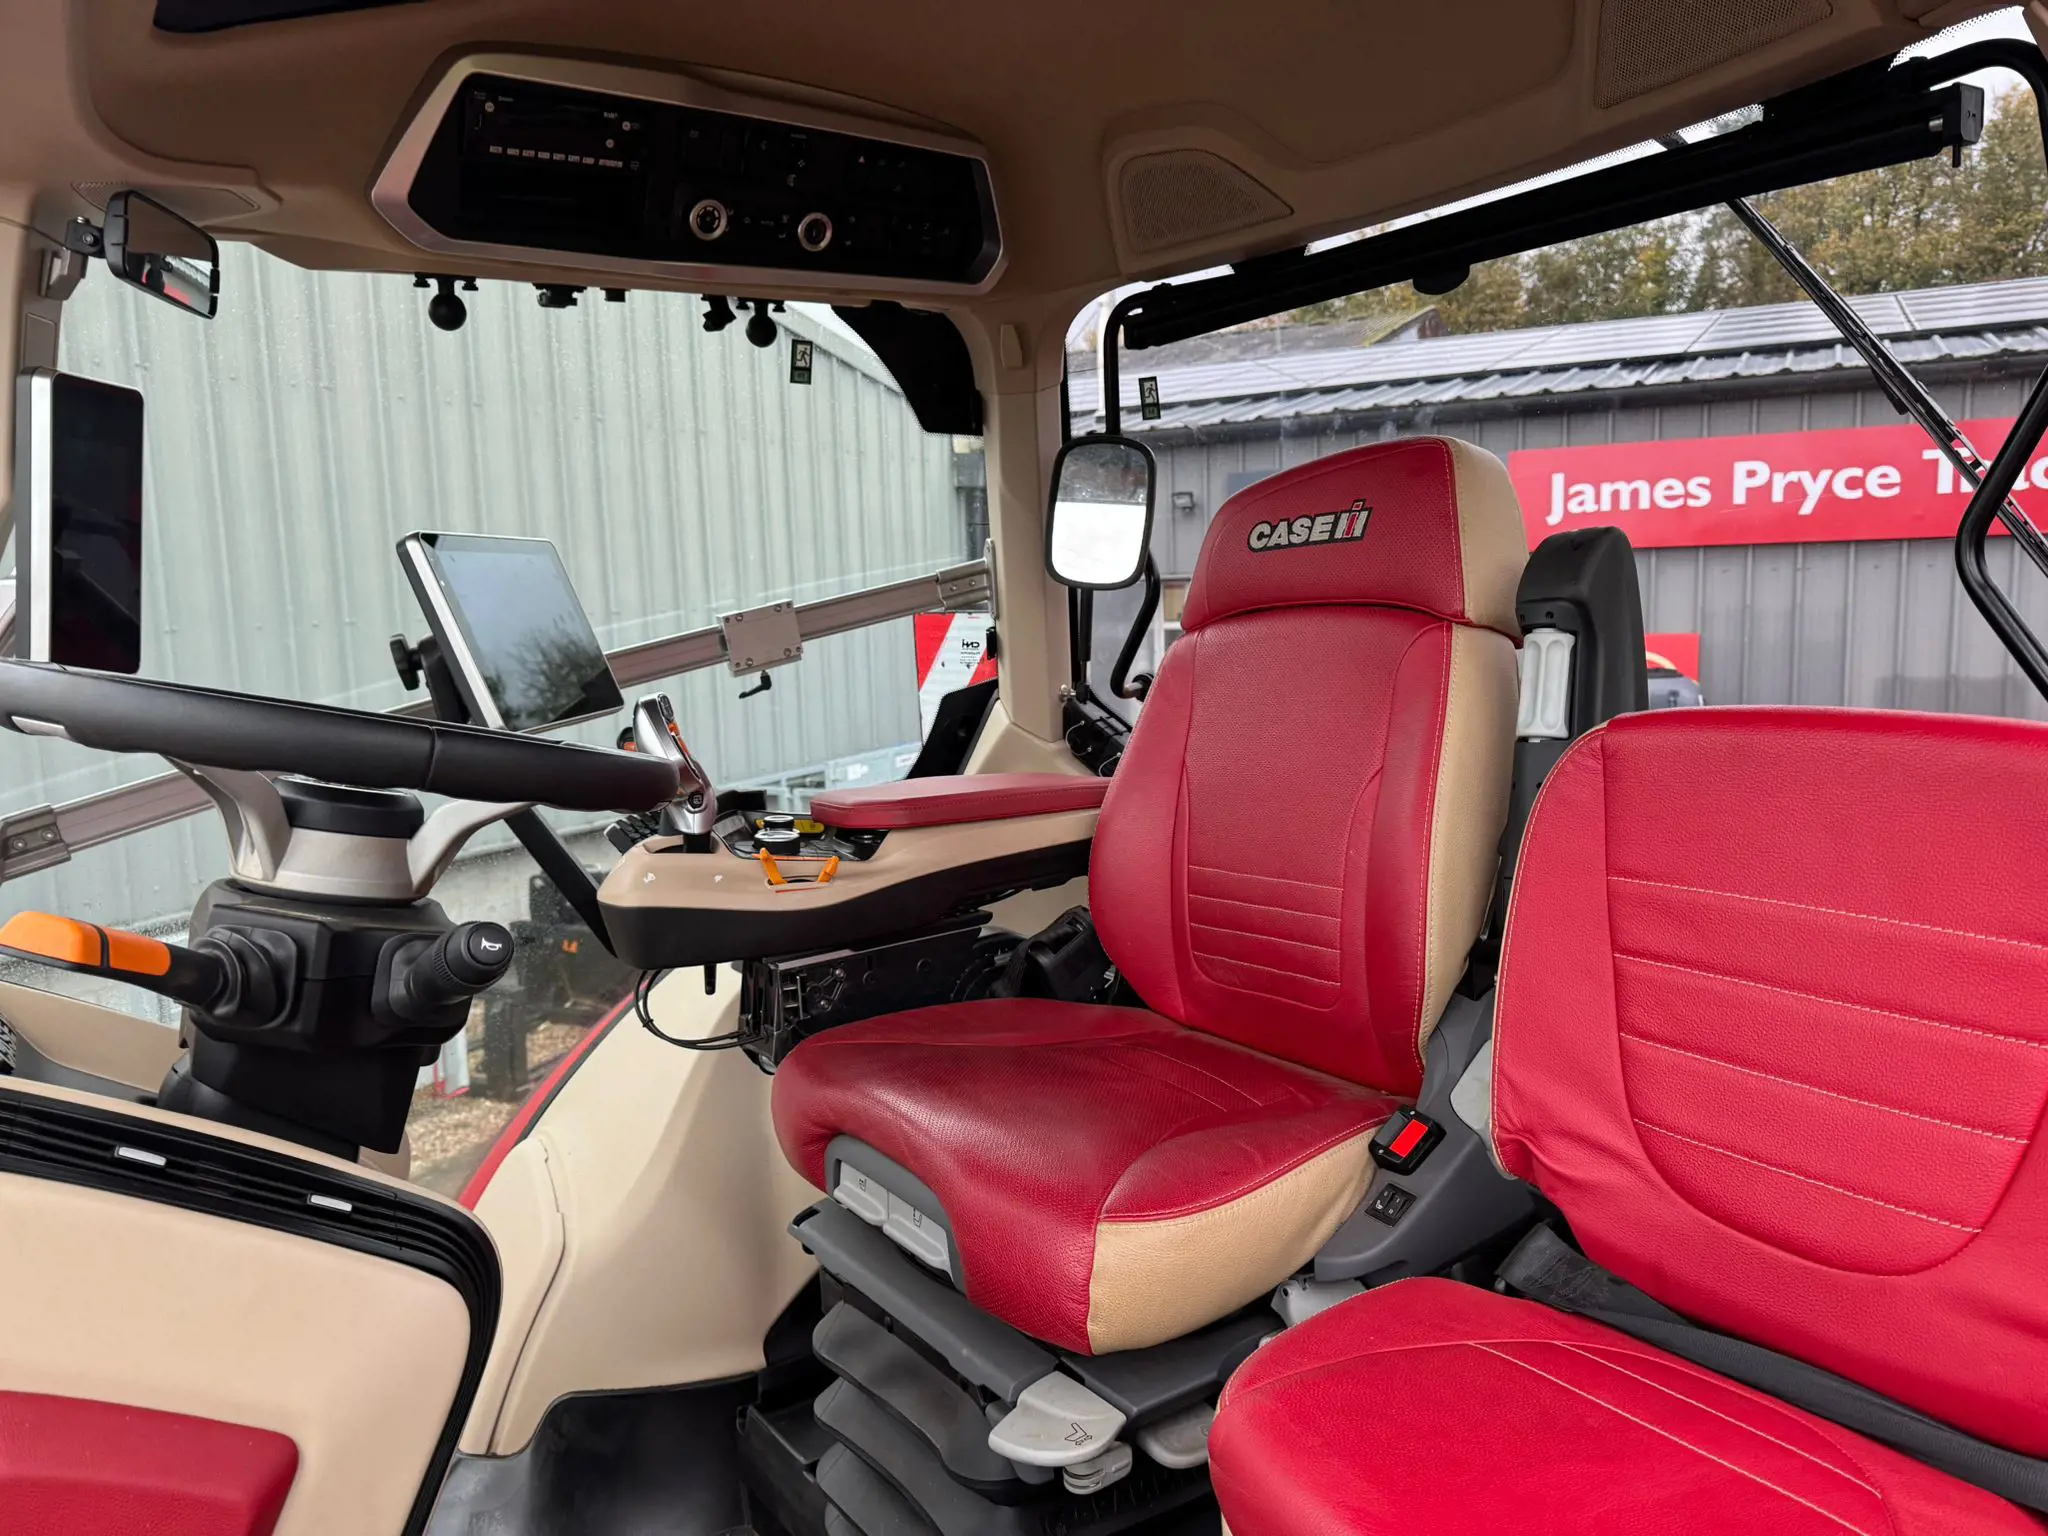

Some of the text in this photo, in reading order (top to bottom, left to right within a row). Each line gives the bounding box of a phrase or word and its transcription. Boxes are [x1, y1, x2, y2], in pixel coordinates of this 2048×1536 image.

[1545, 472, 1712, 526] James
[1732, 460, 1901, 516] Pryce
[1248, 514, 1335, 550] CASE
